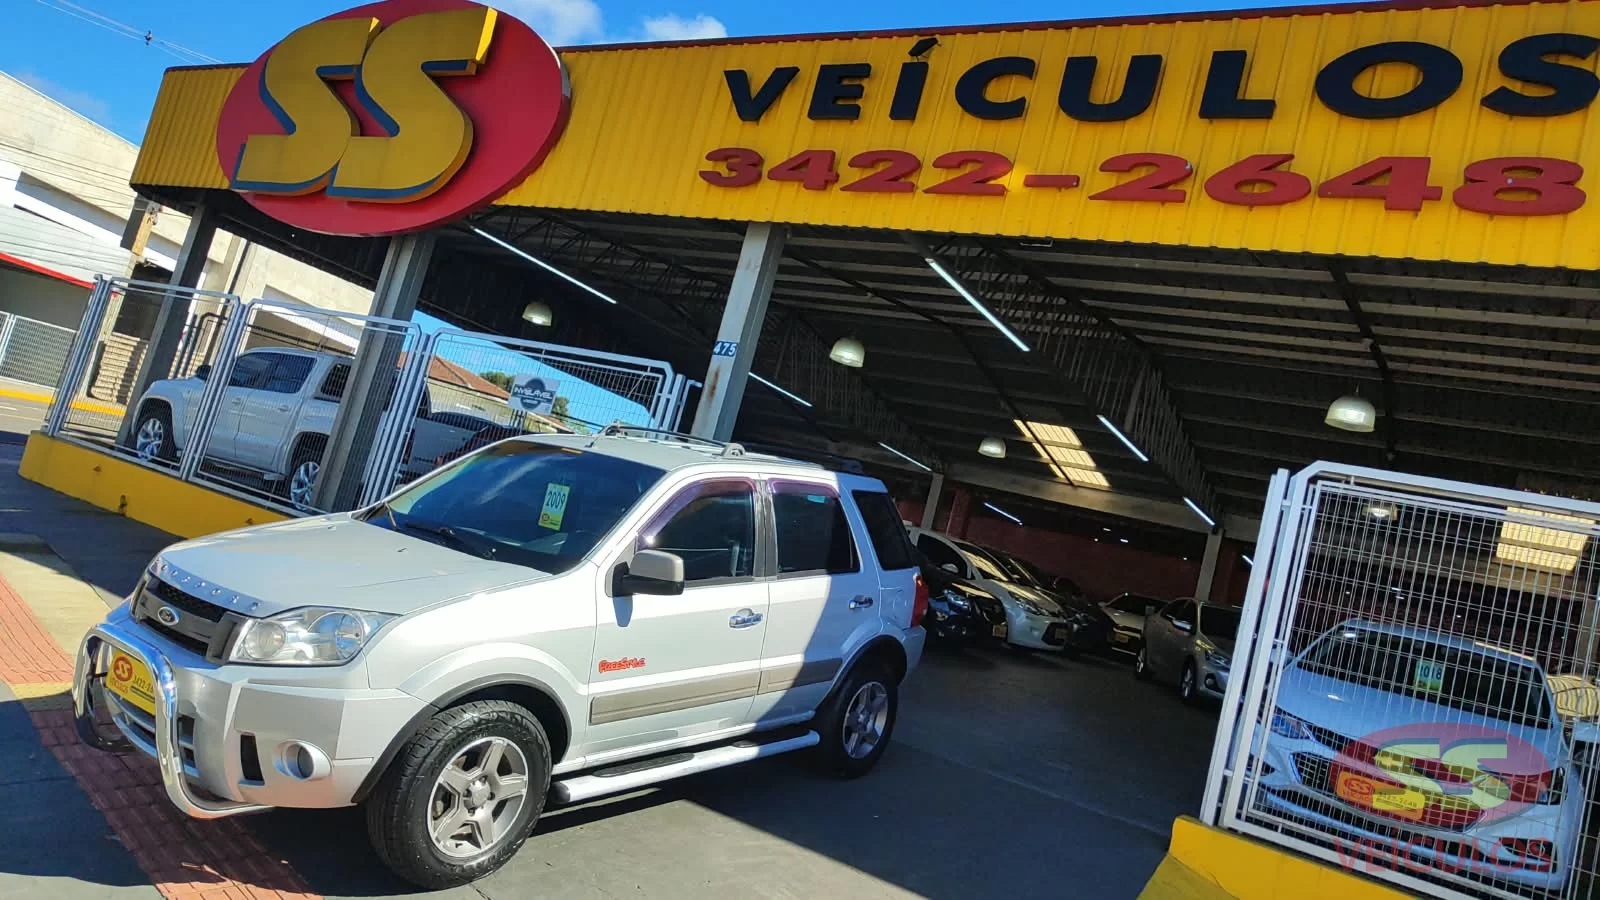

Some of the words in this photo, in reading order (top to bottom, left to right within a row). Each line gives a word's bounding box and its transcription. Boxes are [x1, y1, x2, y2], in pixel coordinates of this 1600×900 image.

[230, 6, 498, 203] SS
[724, 33, 1600, 123] VEÍCULOS
[699, 147, 1587, 216] 3422-2648
[713, 341, 737, 356] 475
[546, 490, 566, 509] 2009
